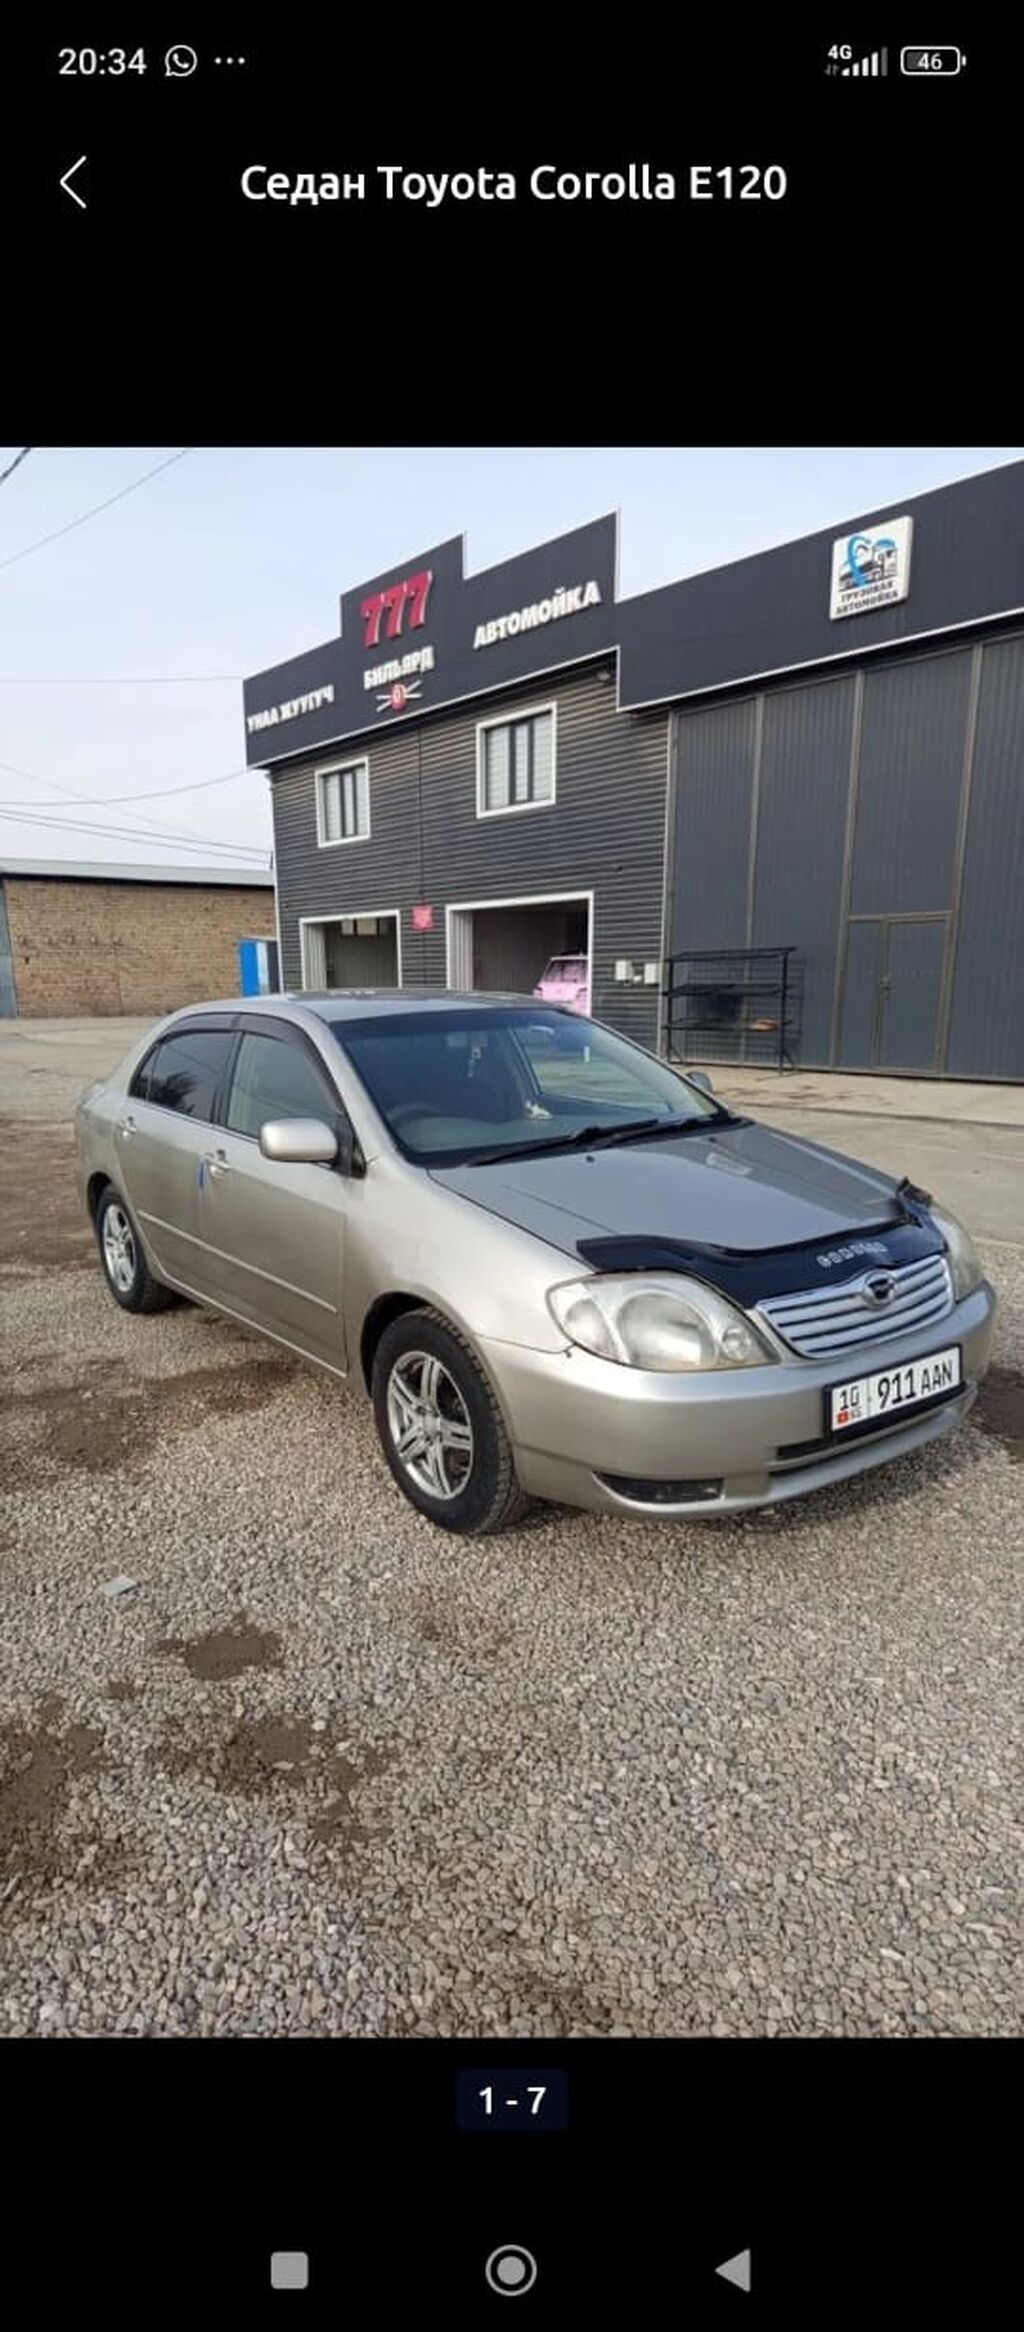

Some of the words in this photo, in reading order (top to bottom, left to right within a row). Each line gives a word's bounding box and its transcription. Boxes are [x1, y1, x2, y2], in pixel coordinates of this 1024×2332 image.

[360, 570, 433, 648] 777
[473, 580, 601, 650] АВТОМОЙКА
[363, 646, 435, 690] БИЛЬЯРД
[839, 1385, 860, 1411] 10
[877, 1368, 916, 1410] 911
[921, 1359, 953, 1396] AAN
